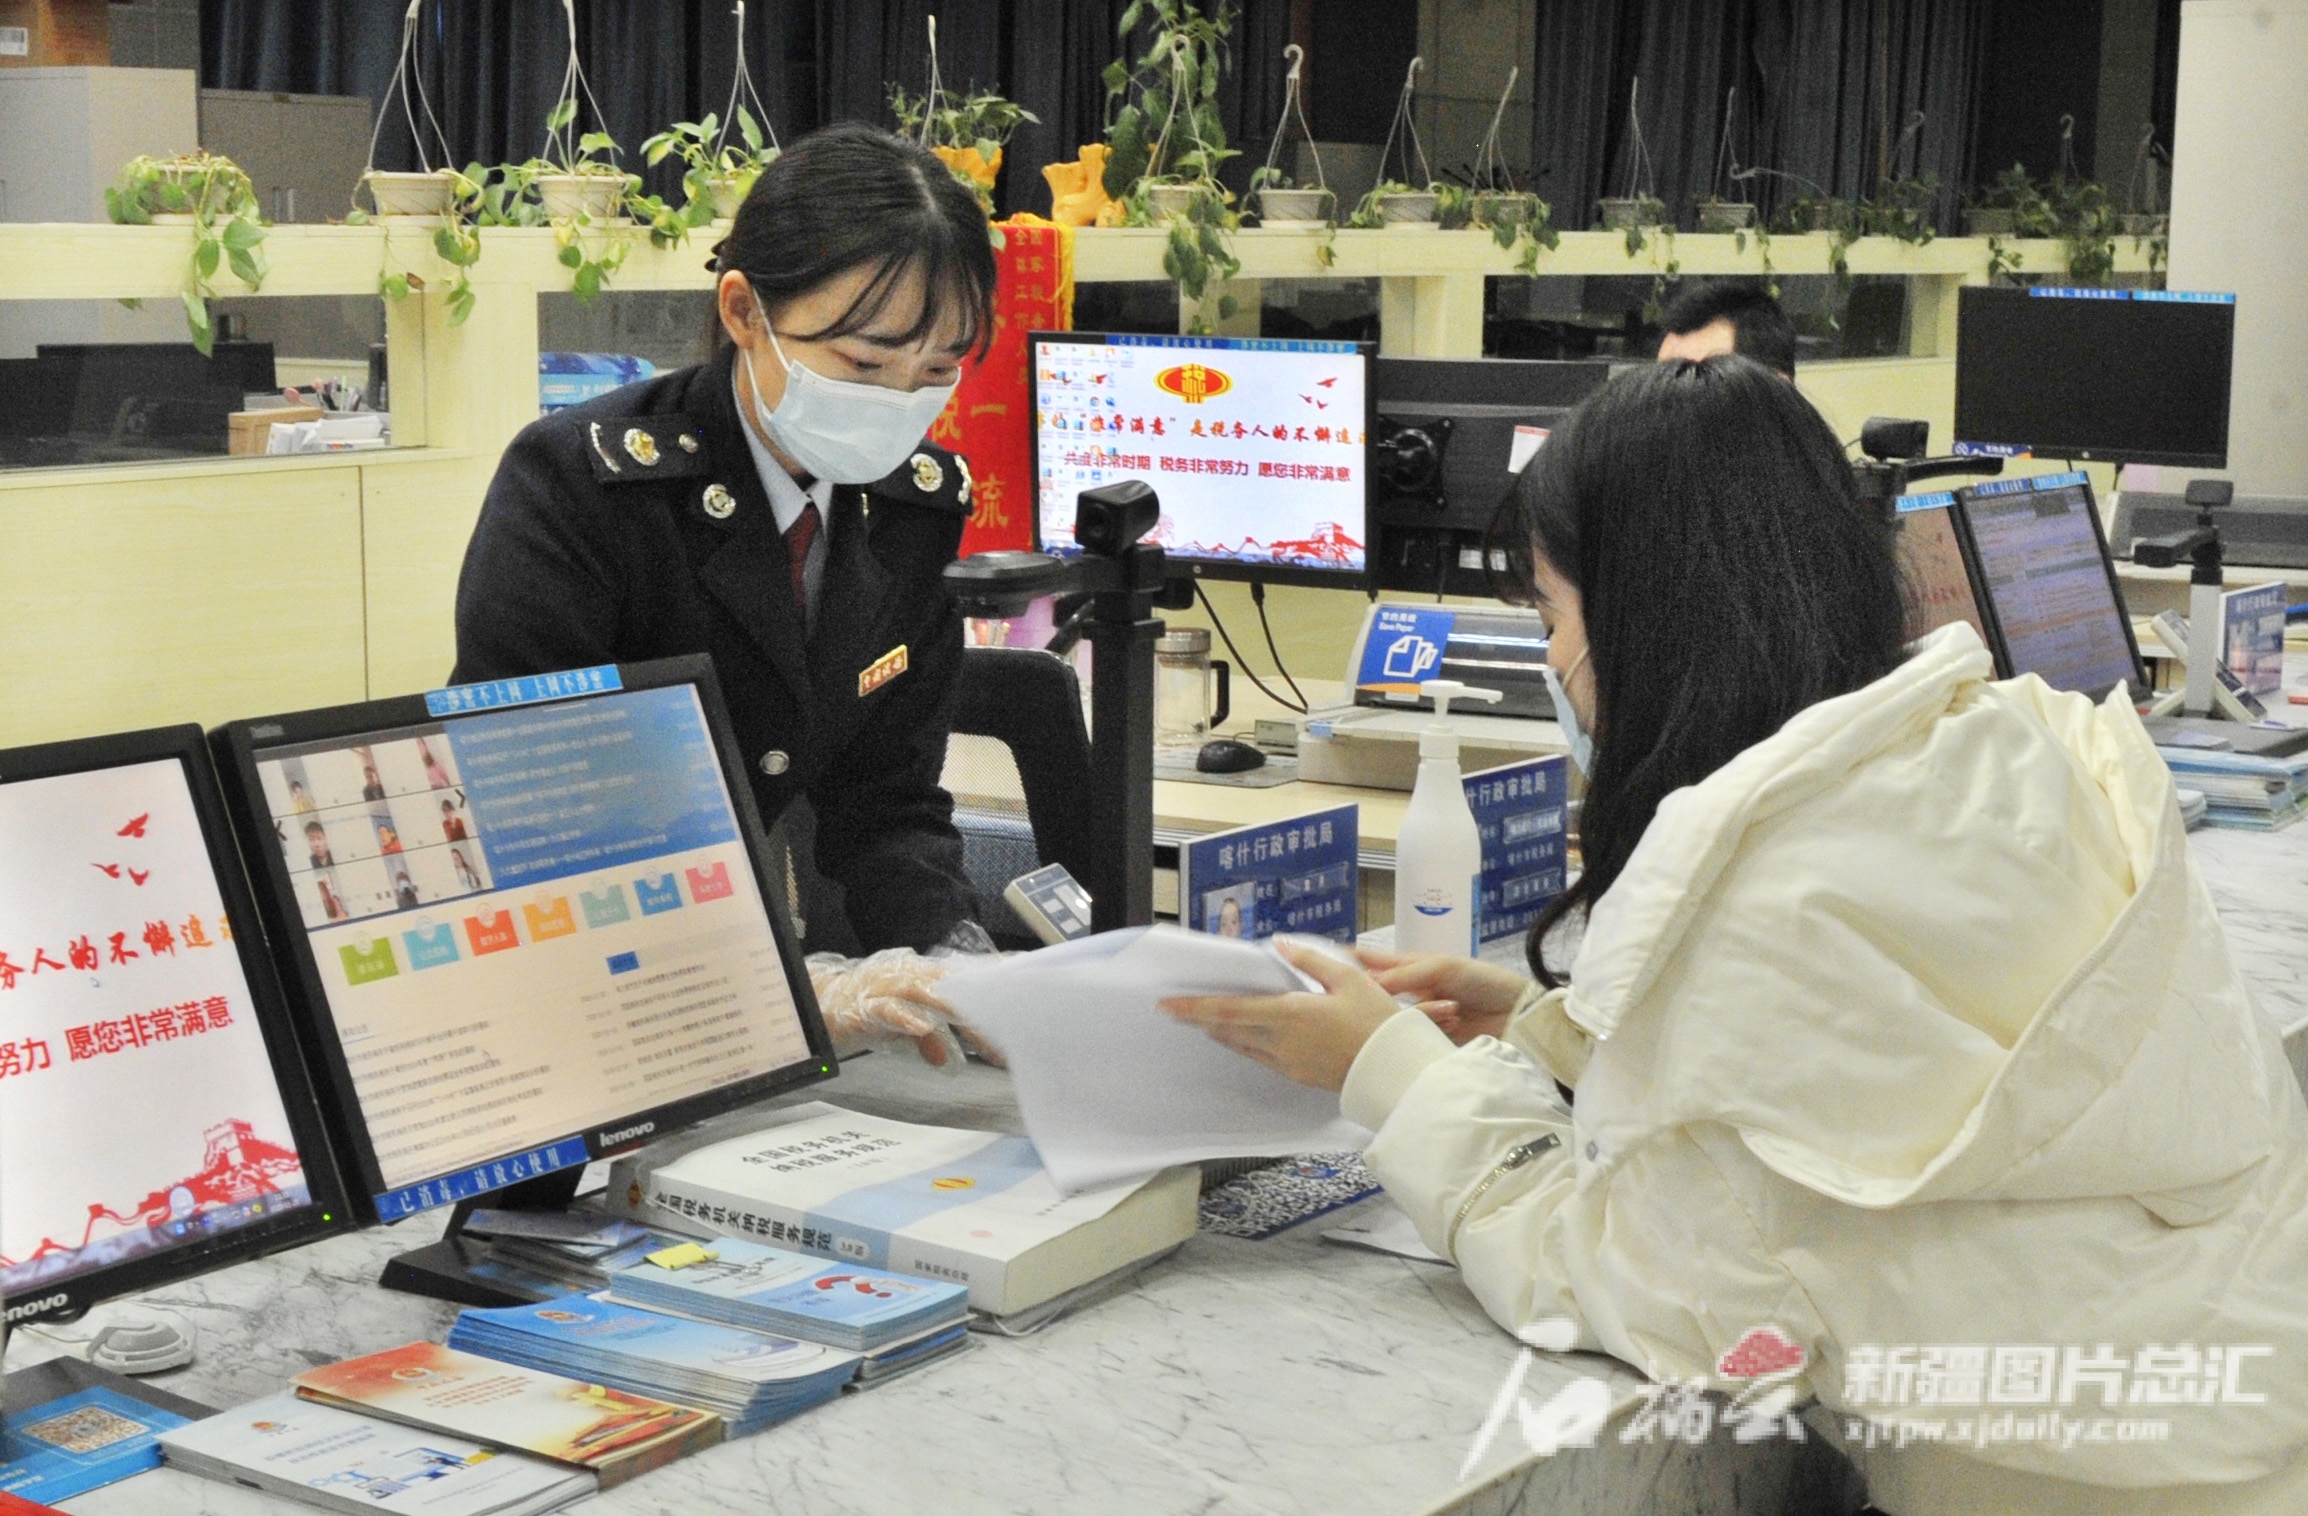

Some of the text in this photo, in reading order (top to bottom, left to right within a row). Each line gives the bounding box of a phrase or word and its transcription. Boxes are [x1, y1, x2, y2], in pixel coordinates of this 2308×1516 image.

[1159, 455, 1249, 477] 税务非常努力
[1258, 461, 1351, 482] 愿您非常满意
[1218, 821, 1334, 870] 喀什行政审批局
[64, 995, 234, 1062] 愿您非常满意
[599, 1121, 655, 1148] lenovo
